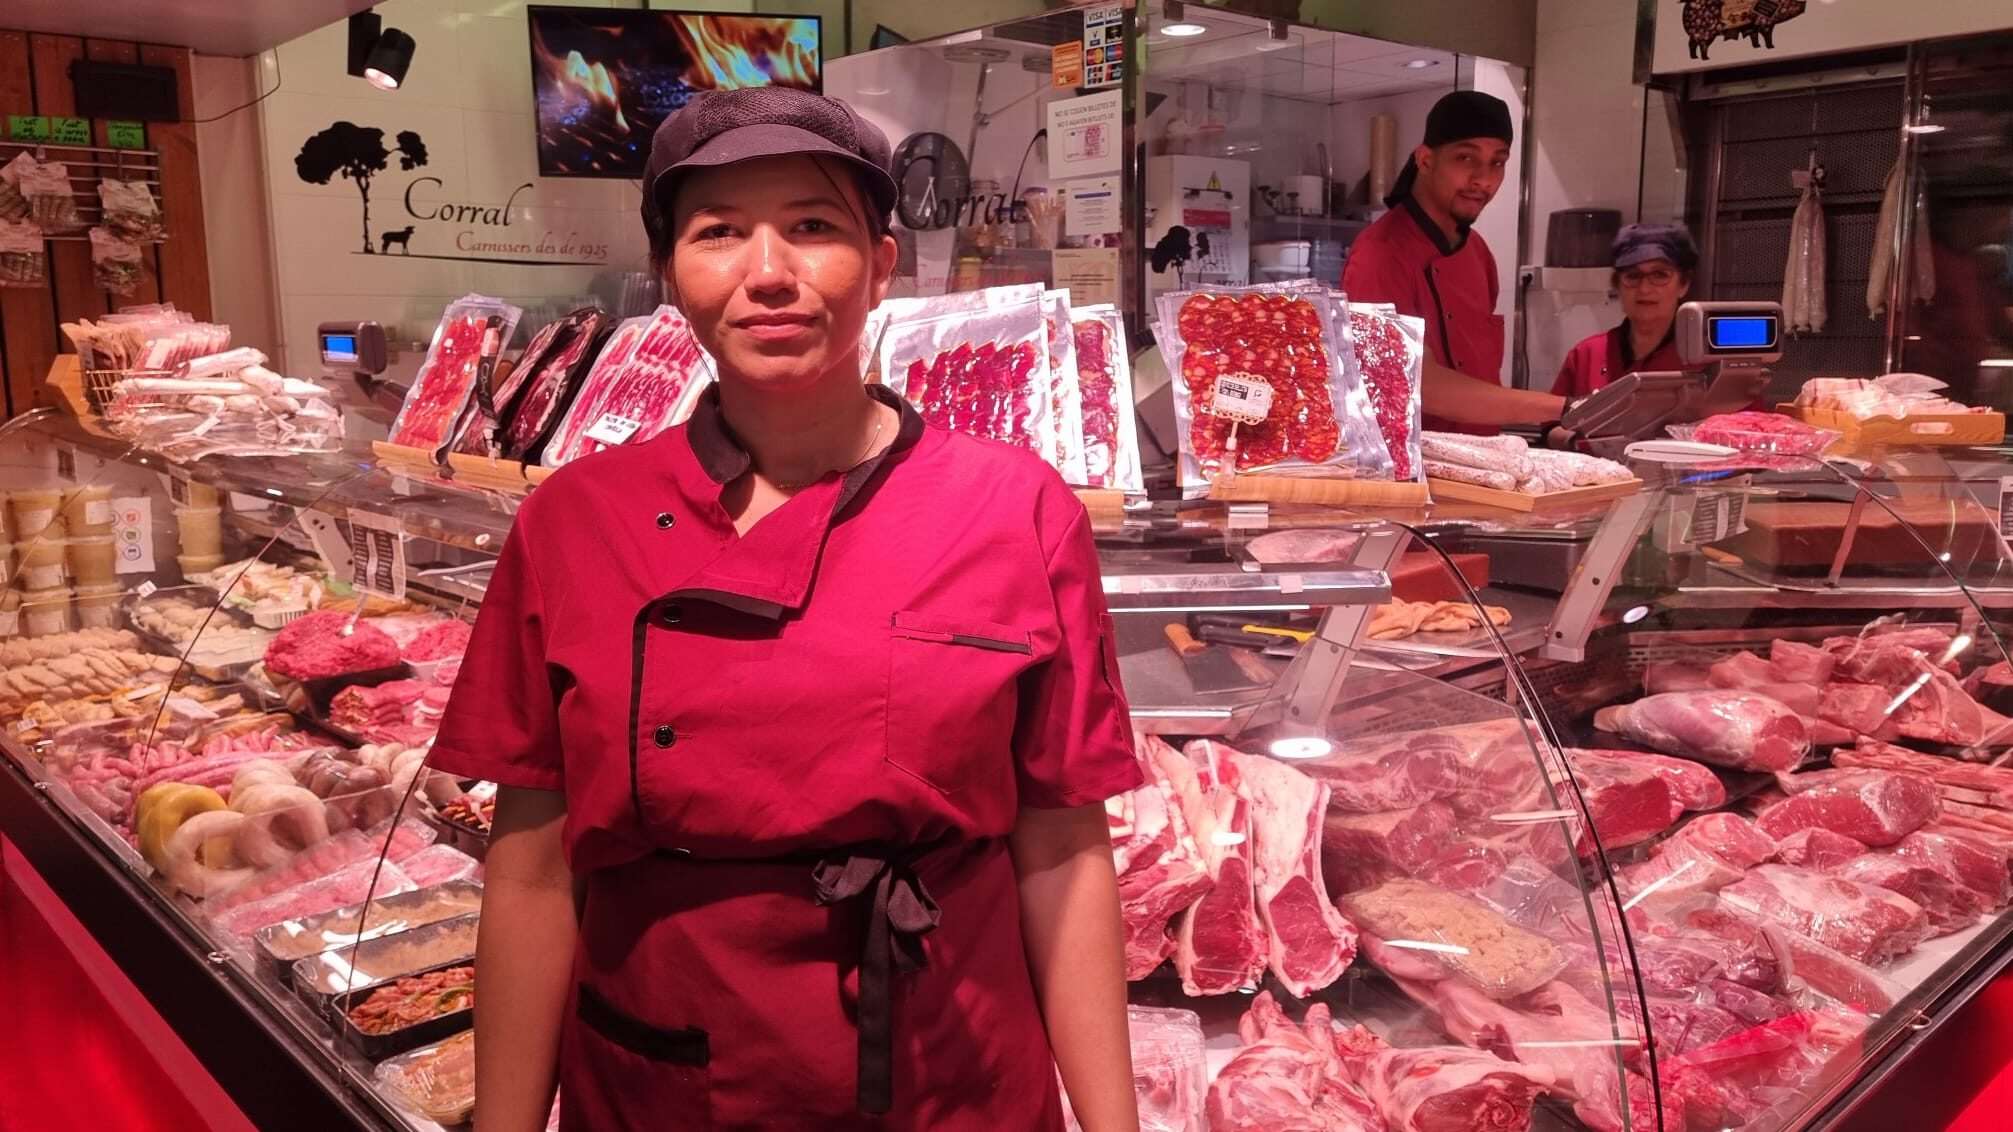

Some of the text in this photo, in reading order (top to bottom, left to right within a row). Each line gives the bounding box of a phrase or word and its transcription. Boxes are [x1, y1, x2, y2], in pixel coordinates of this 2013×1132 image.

[404, 176, 534, 227] Corral
[900, 128, 1048, 230] Corral
[560, 232, 577, 256] de
[579, 244, 609, 260] 1925
